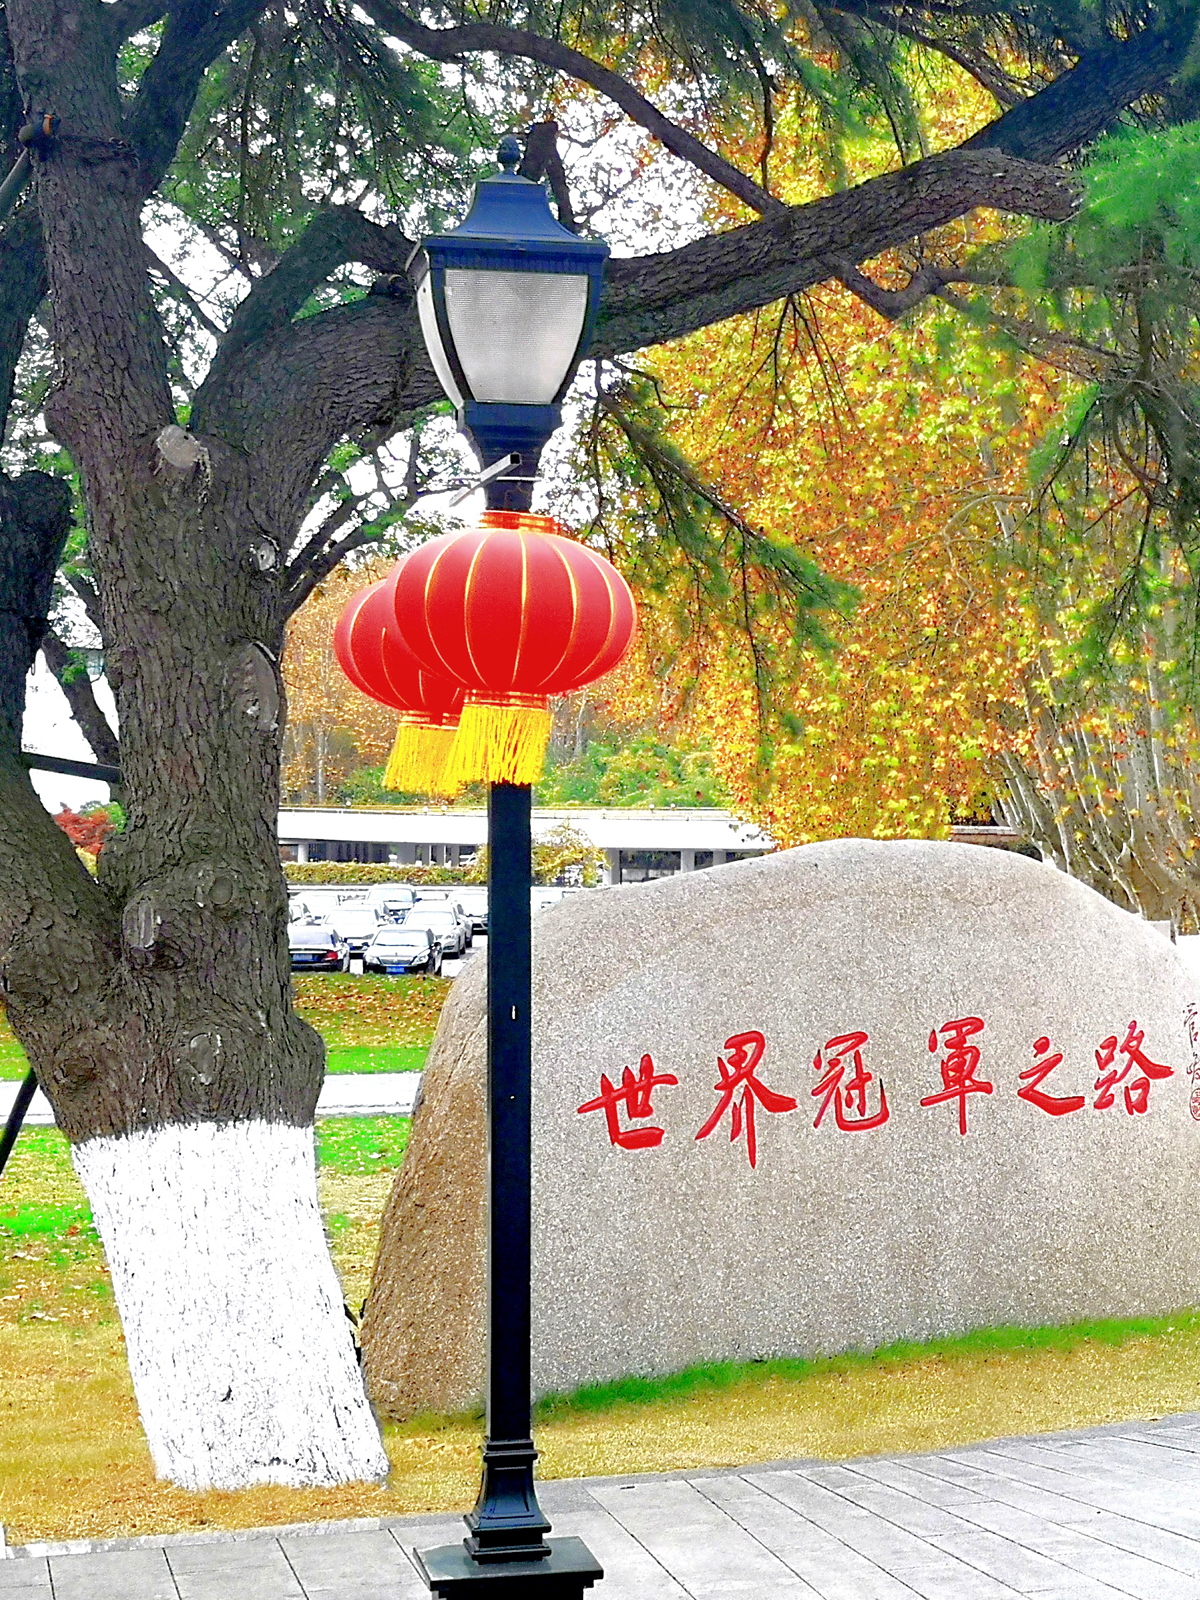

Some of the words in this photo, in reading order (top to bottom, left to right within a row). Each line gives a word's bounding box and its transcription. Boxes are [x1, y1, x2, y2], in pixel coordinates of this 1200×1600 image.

[577, 1016, 1174, 1168] 世界冠軍之路
